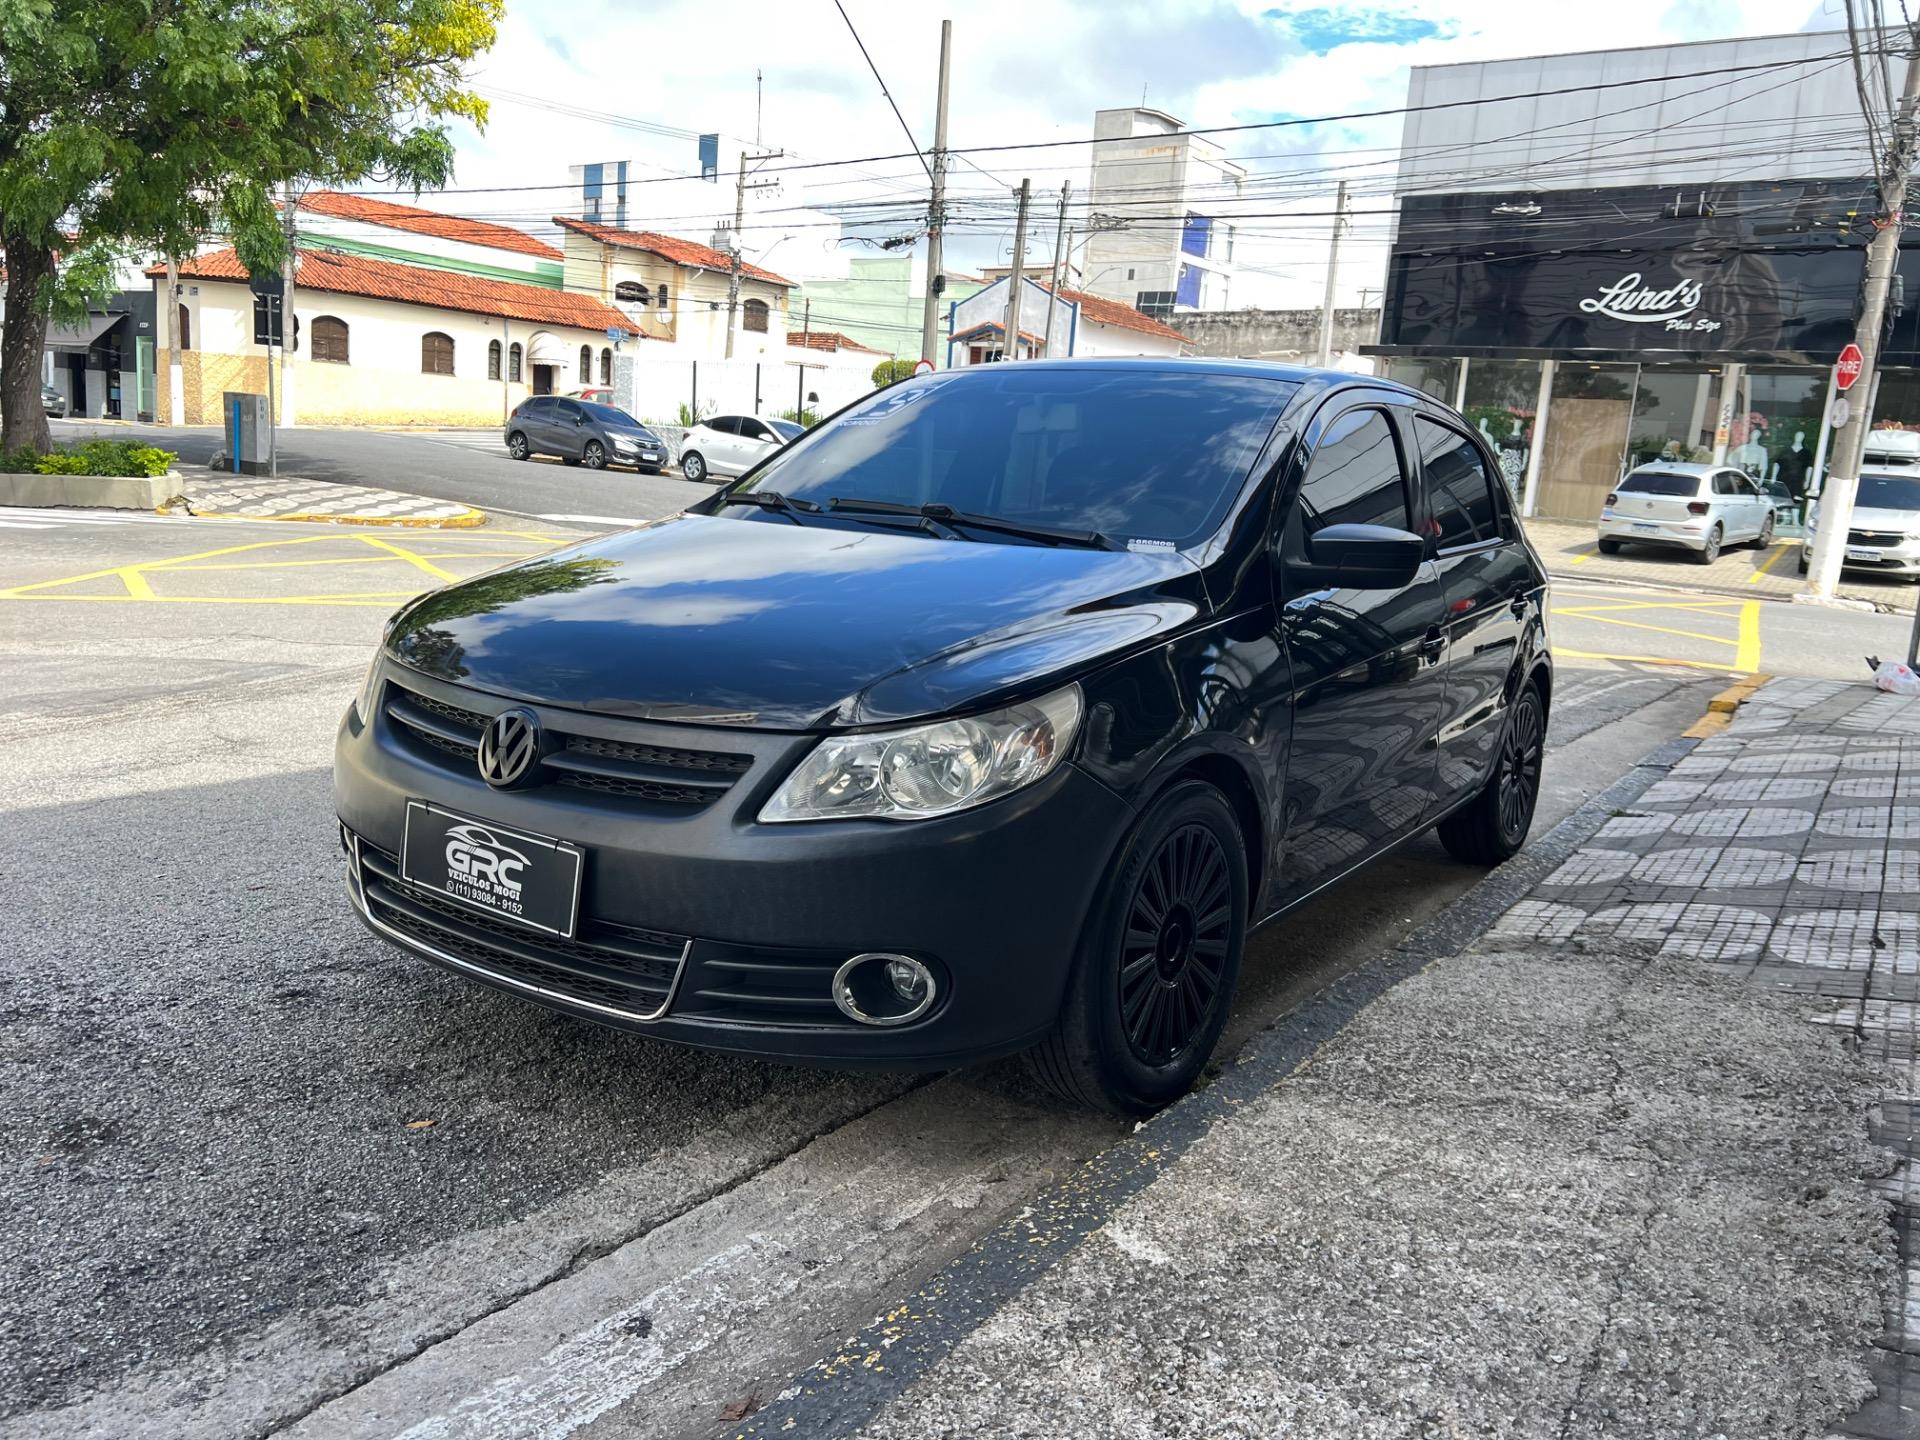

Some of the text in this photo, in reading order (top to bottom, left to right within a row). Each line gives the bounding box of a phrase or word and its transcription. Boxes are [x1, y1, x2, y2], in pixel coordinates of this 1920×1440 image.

[1579, 273, 1703, 322] Lund's
[1665, 319, 1692, 331] Plus
[1838, 360, 1861, 374] PARE
[445, 840, 524, 892] GRC
[447, 868, 520, 901] VEICULOS MOGI
[455, 882, 471, 899] (11)
[472, 888, 496, 905] 93084
[502, 899, 523, 915] 9152
